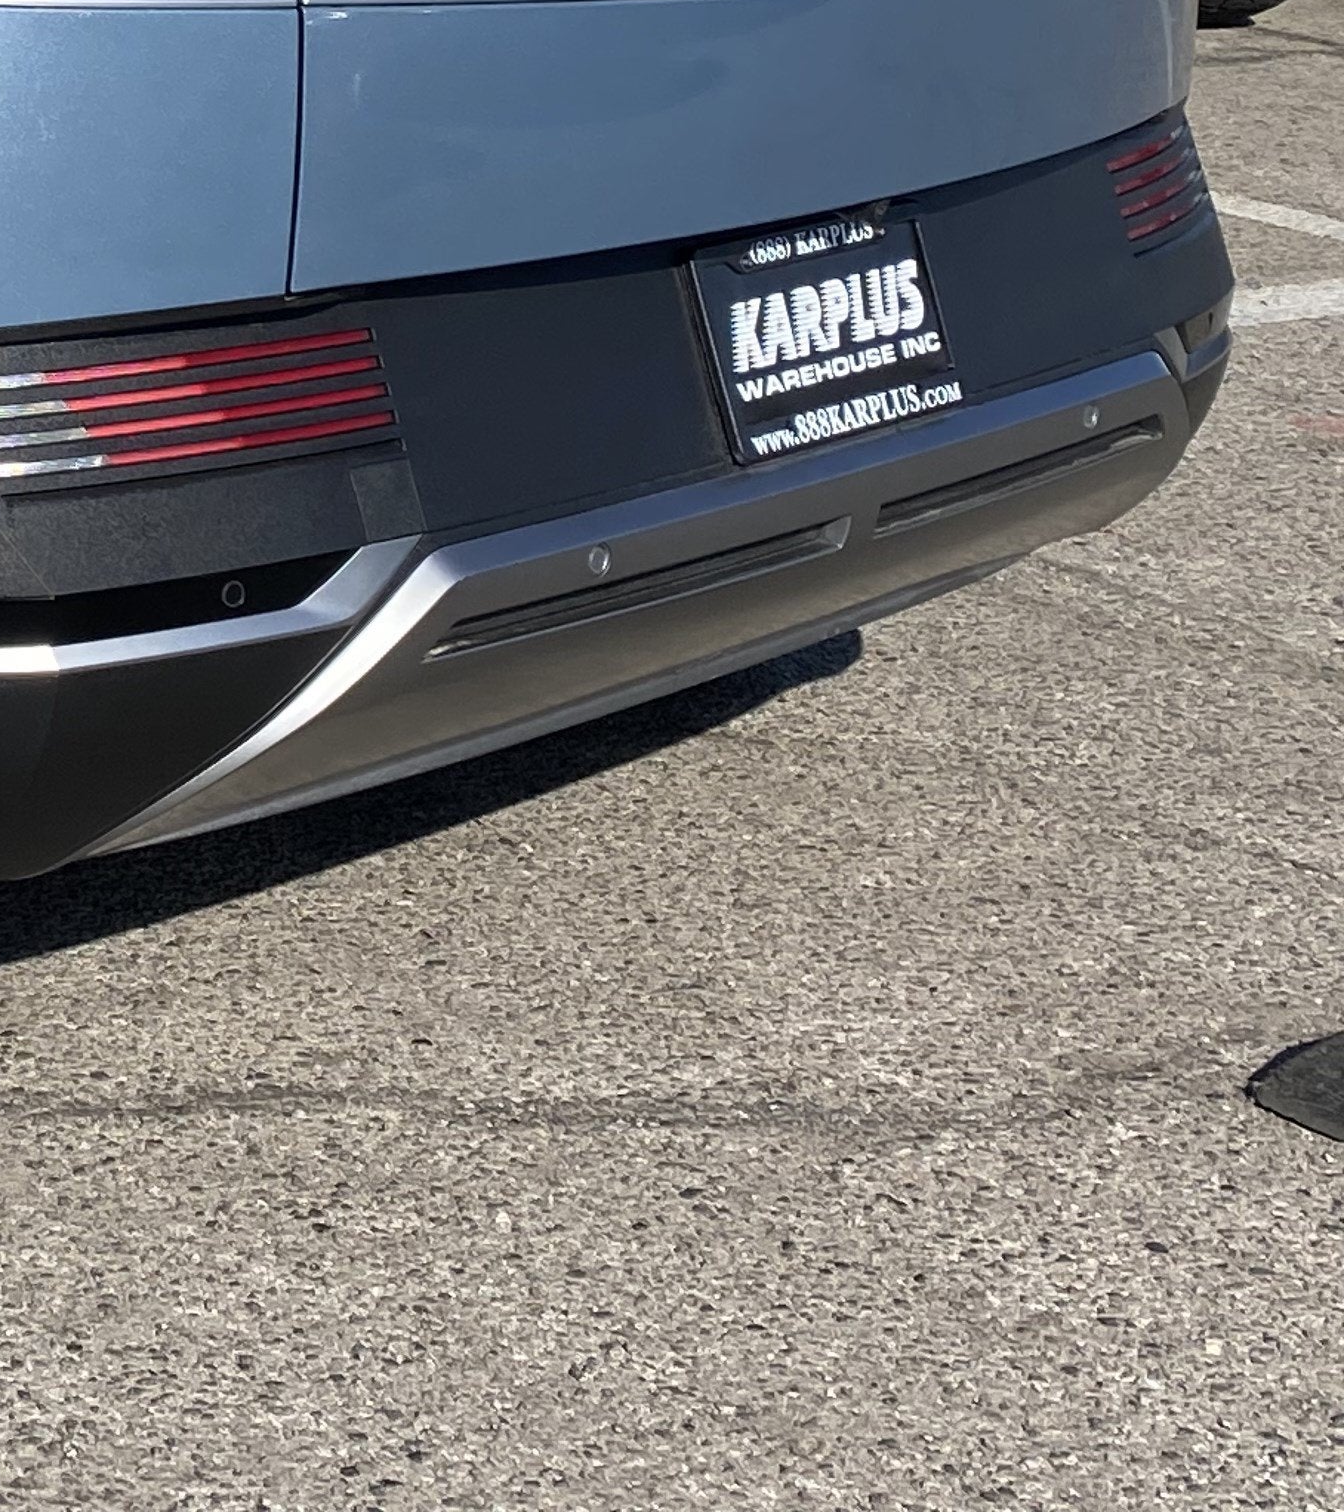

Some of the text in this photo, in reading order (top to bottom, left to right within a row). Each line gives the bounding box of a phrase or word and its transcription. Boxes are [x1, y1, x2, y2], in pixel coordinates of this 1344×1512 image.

[793, 220, 874, 256] KARPLUS
[729, 258, 925, 373] KARPLUS
[736, 331, 942, 402] WAREHOUSE INC
